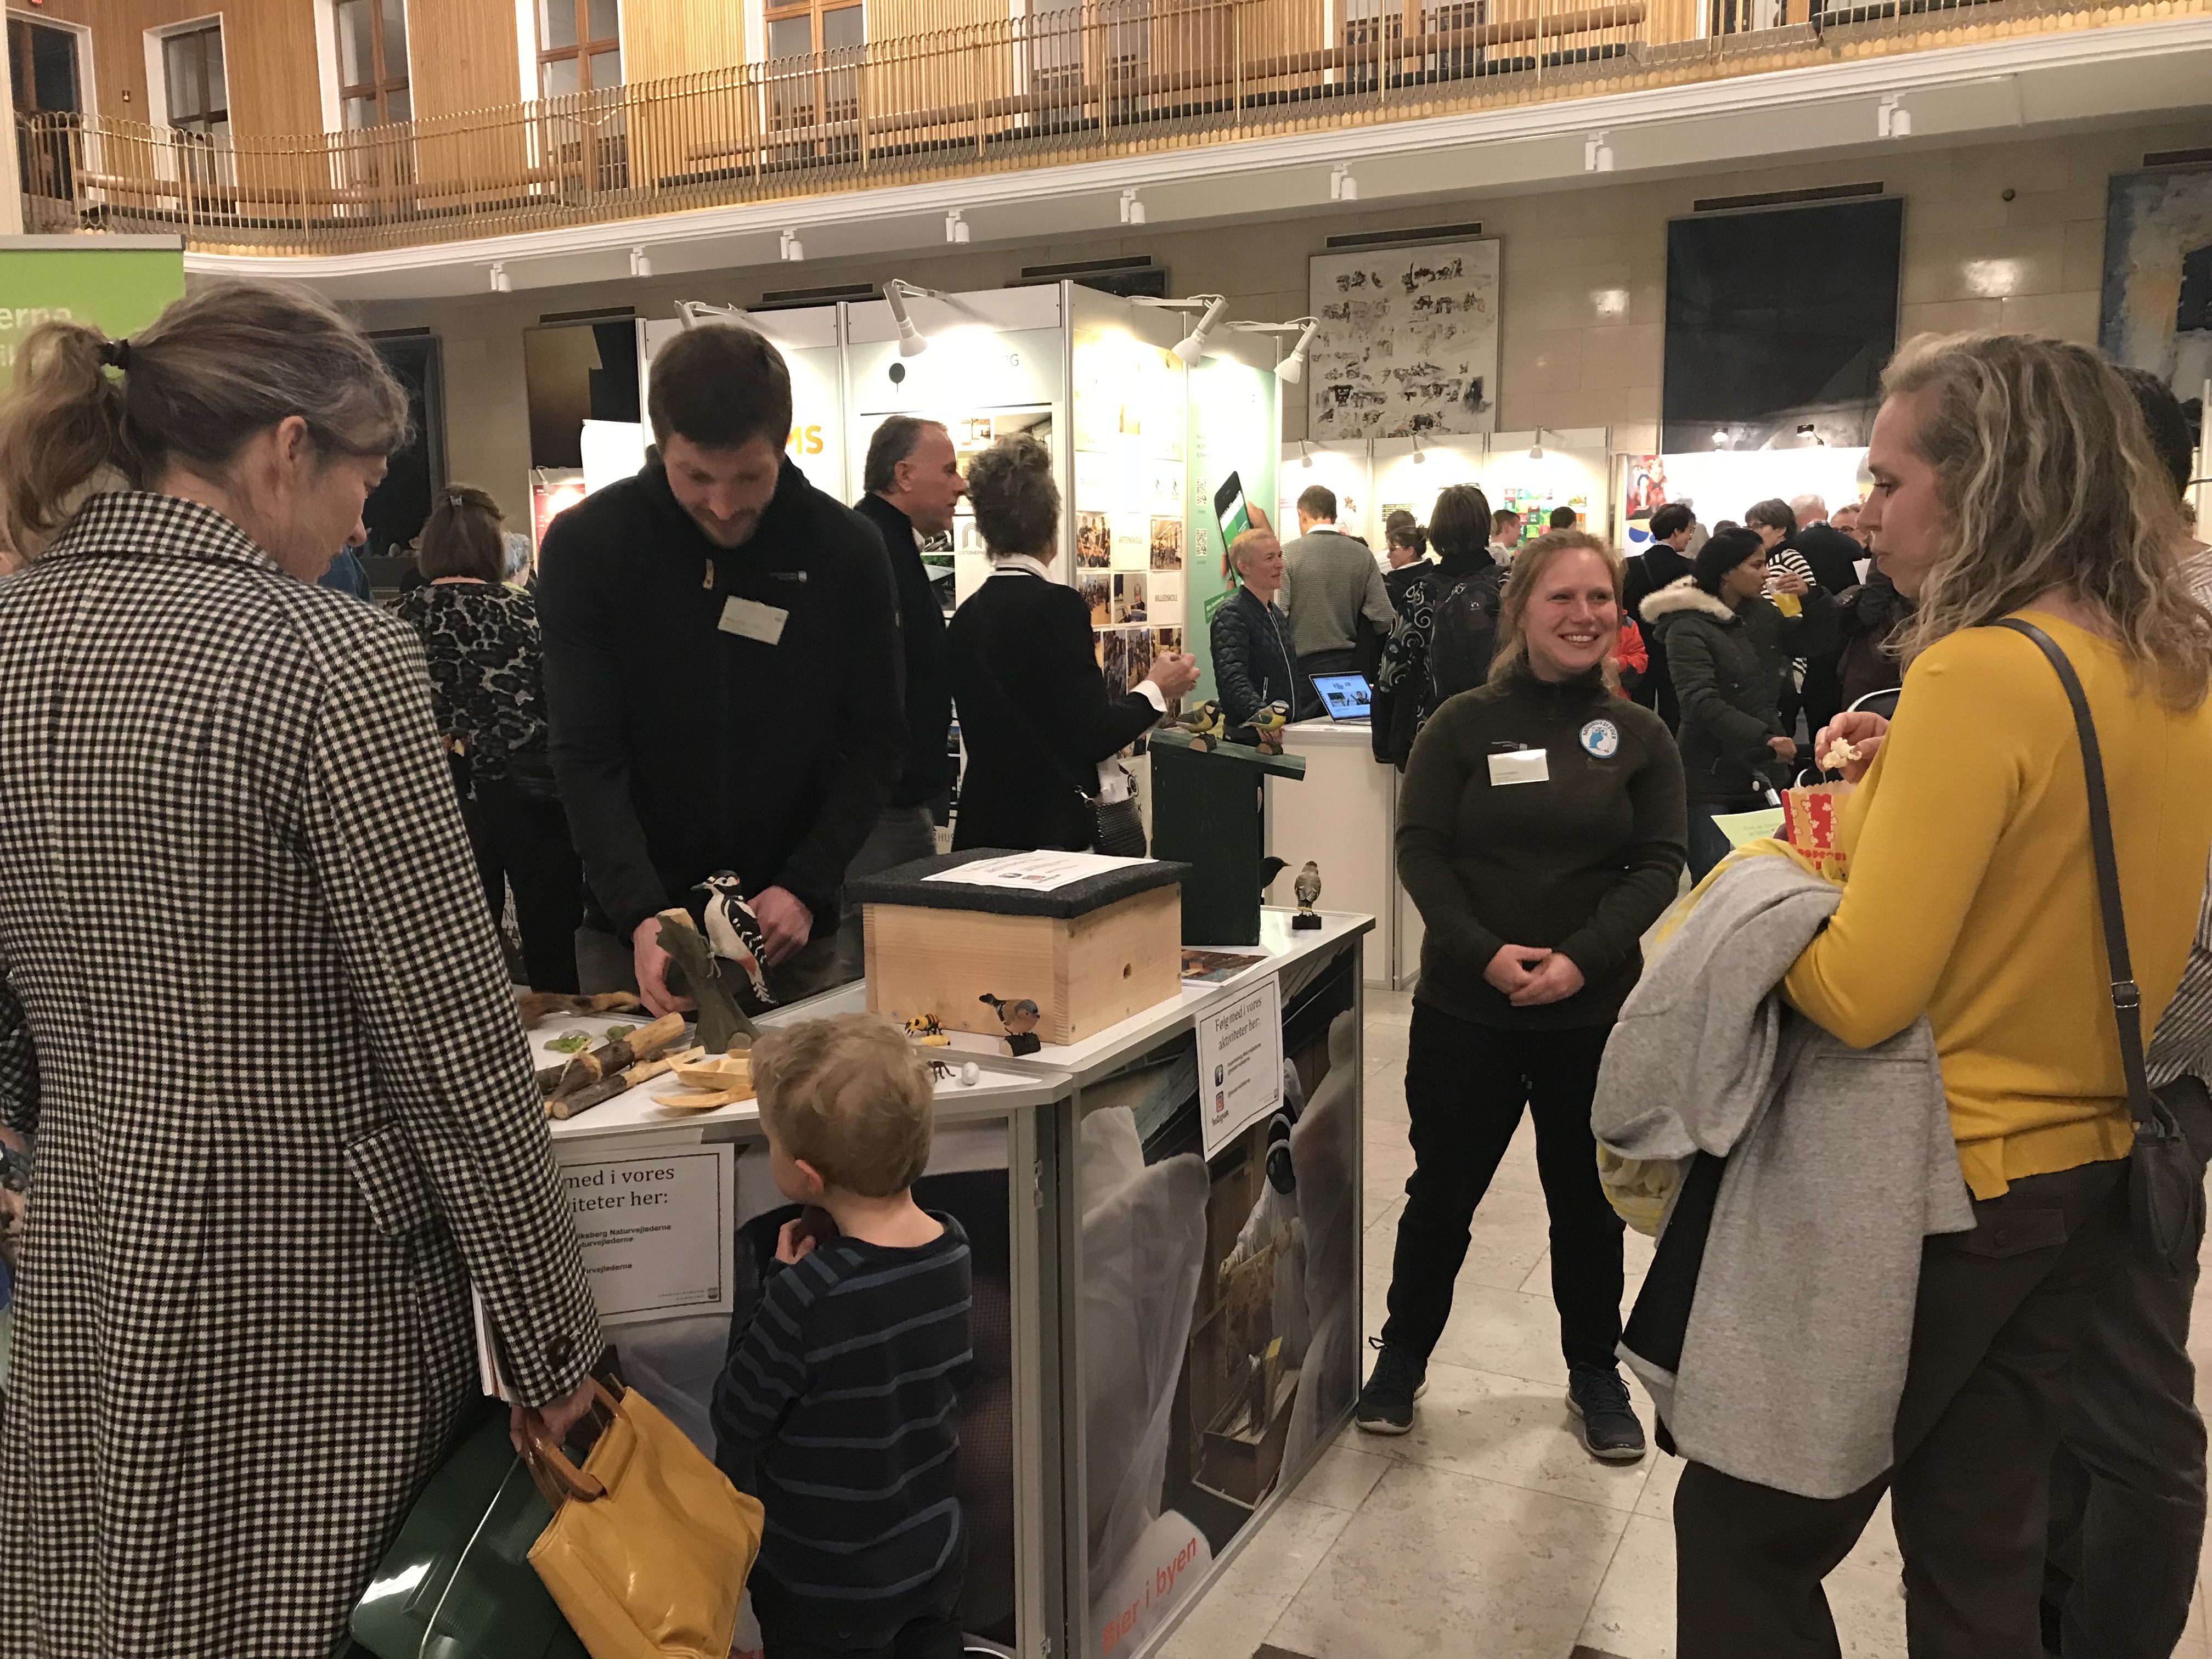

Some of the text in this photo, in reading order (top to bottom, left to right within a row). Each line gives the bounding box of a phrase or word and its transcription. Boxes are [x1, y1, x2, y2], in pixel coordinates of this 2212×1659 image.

[1215, 1015, 1229, 1032] Følg
[1229, 1005, 1243, 1024] med
[1246, 997, 1262, 1013] vores
[1218, 1024, 1248, 1051] aktiviteter
[563, 1167, 675, 1188] med i vores
[572, 1191, 668, 1213] iteter her:
[610, 1224, 672, 1236] Naturvejlederne
[1145, 1579, 1150, 1609] i
[1156, 1537, 1196, 1598] byen
